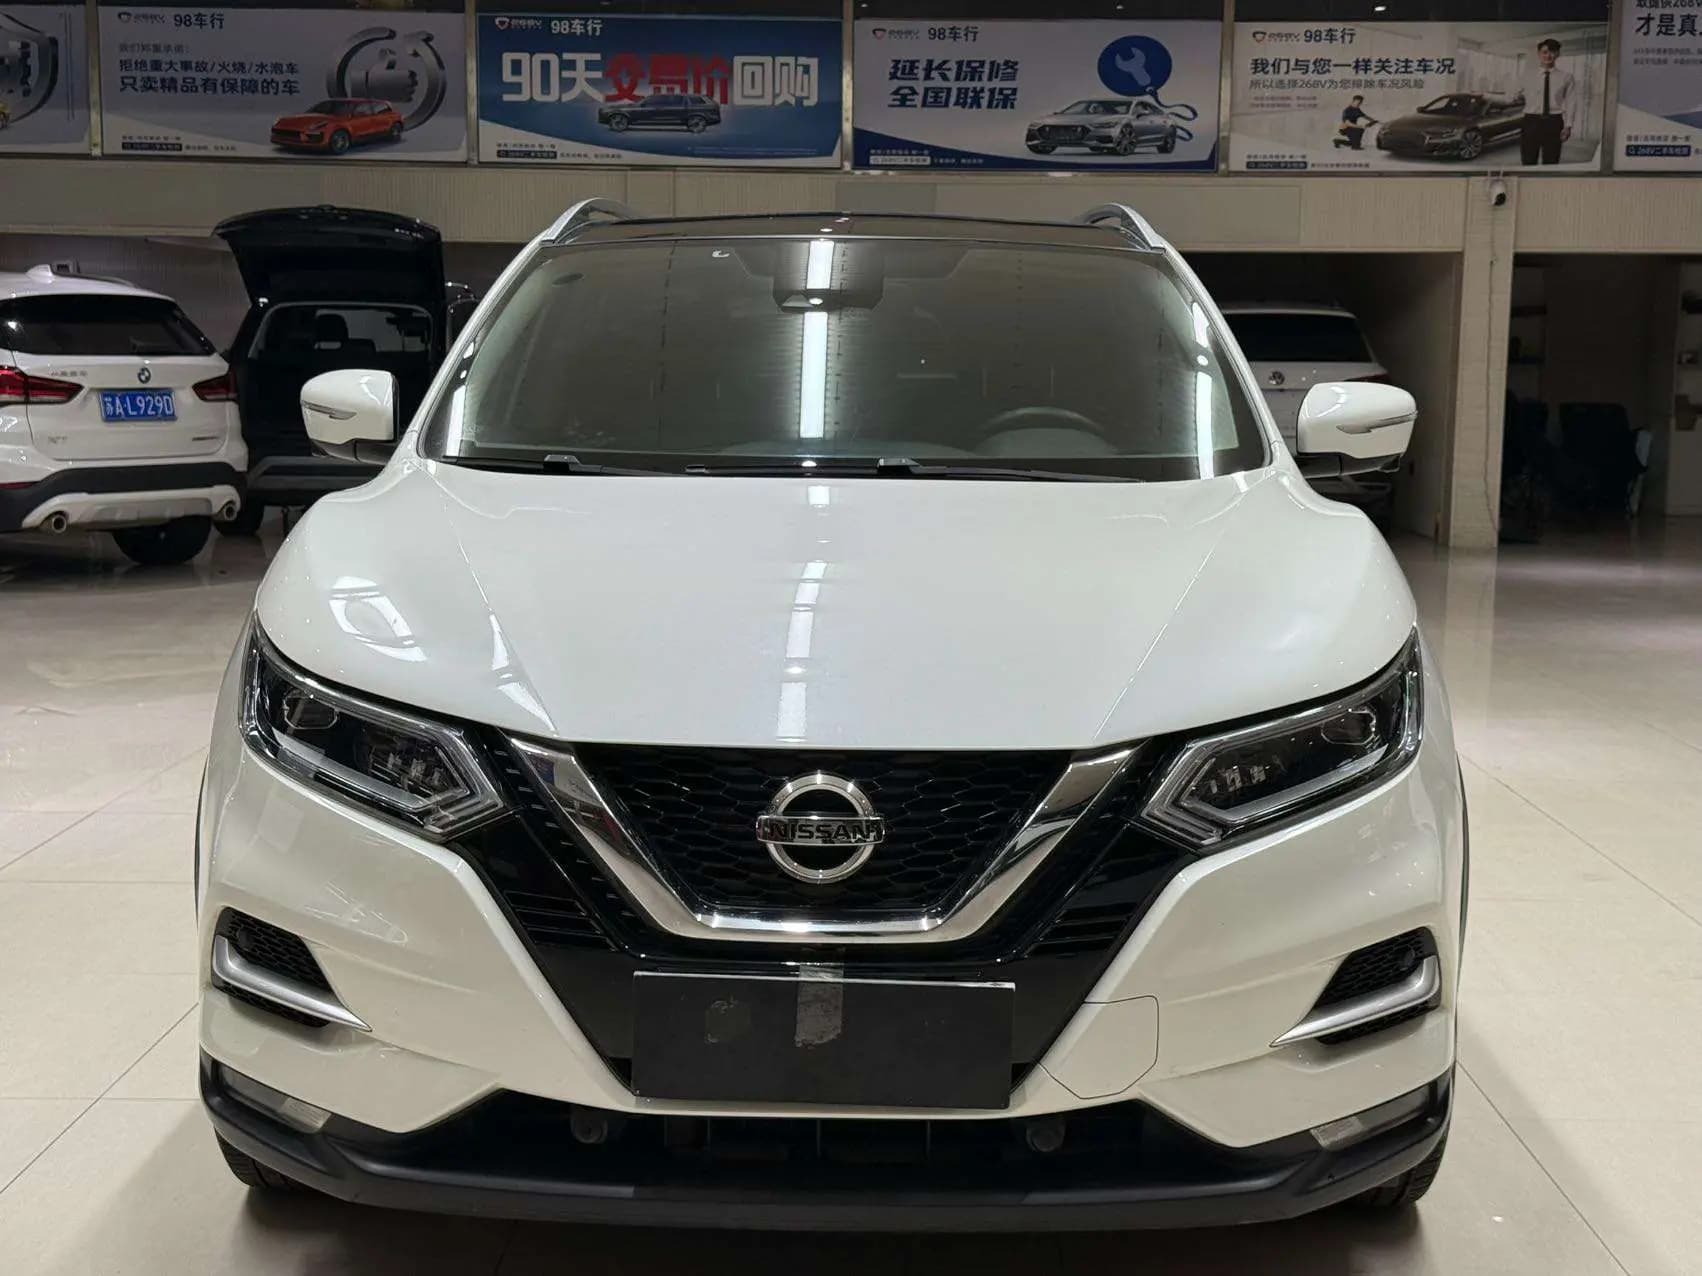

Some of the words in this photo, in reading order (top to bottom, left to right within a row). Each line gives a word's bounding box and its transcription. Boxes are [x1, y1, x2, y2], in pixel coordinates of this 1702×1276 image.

[174, 13, 225, 29] 98车行
[551, 19, 603, 36] 98车行
[1635, 13, 1702, 37] 才是真
[928, 26, 979, 42] 98车行
[1304, 28, 1357, 44] 98车行
[119, 59, 299, 75] 拒绝重大事故/火烧/水泡车
[888, 58, 1019, 82] 延长保修
[1249, 57, 1456, 75] 我们与您一样关注车况
[119, 76, 300, 96] 只卖精品有保障的车
[888, 86, 1018, 110] 全国联保
[770, 821, 874, 841] NISSAN
